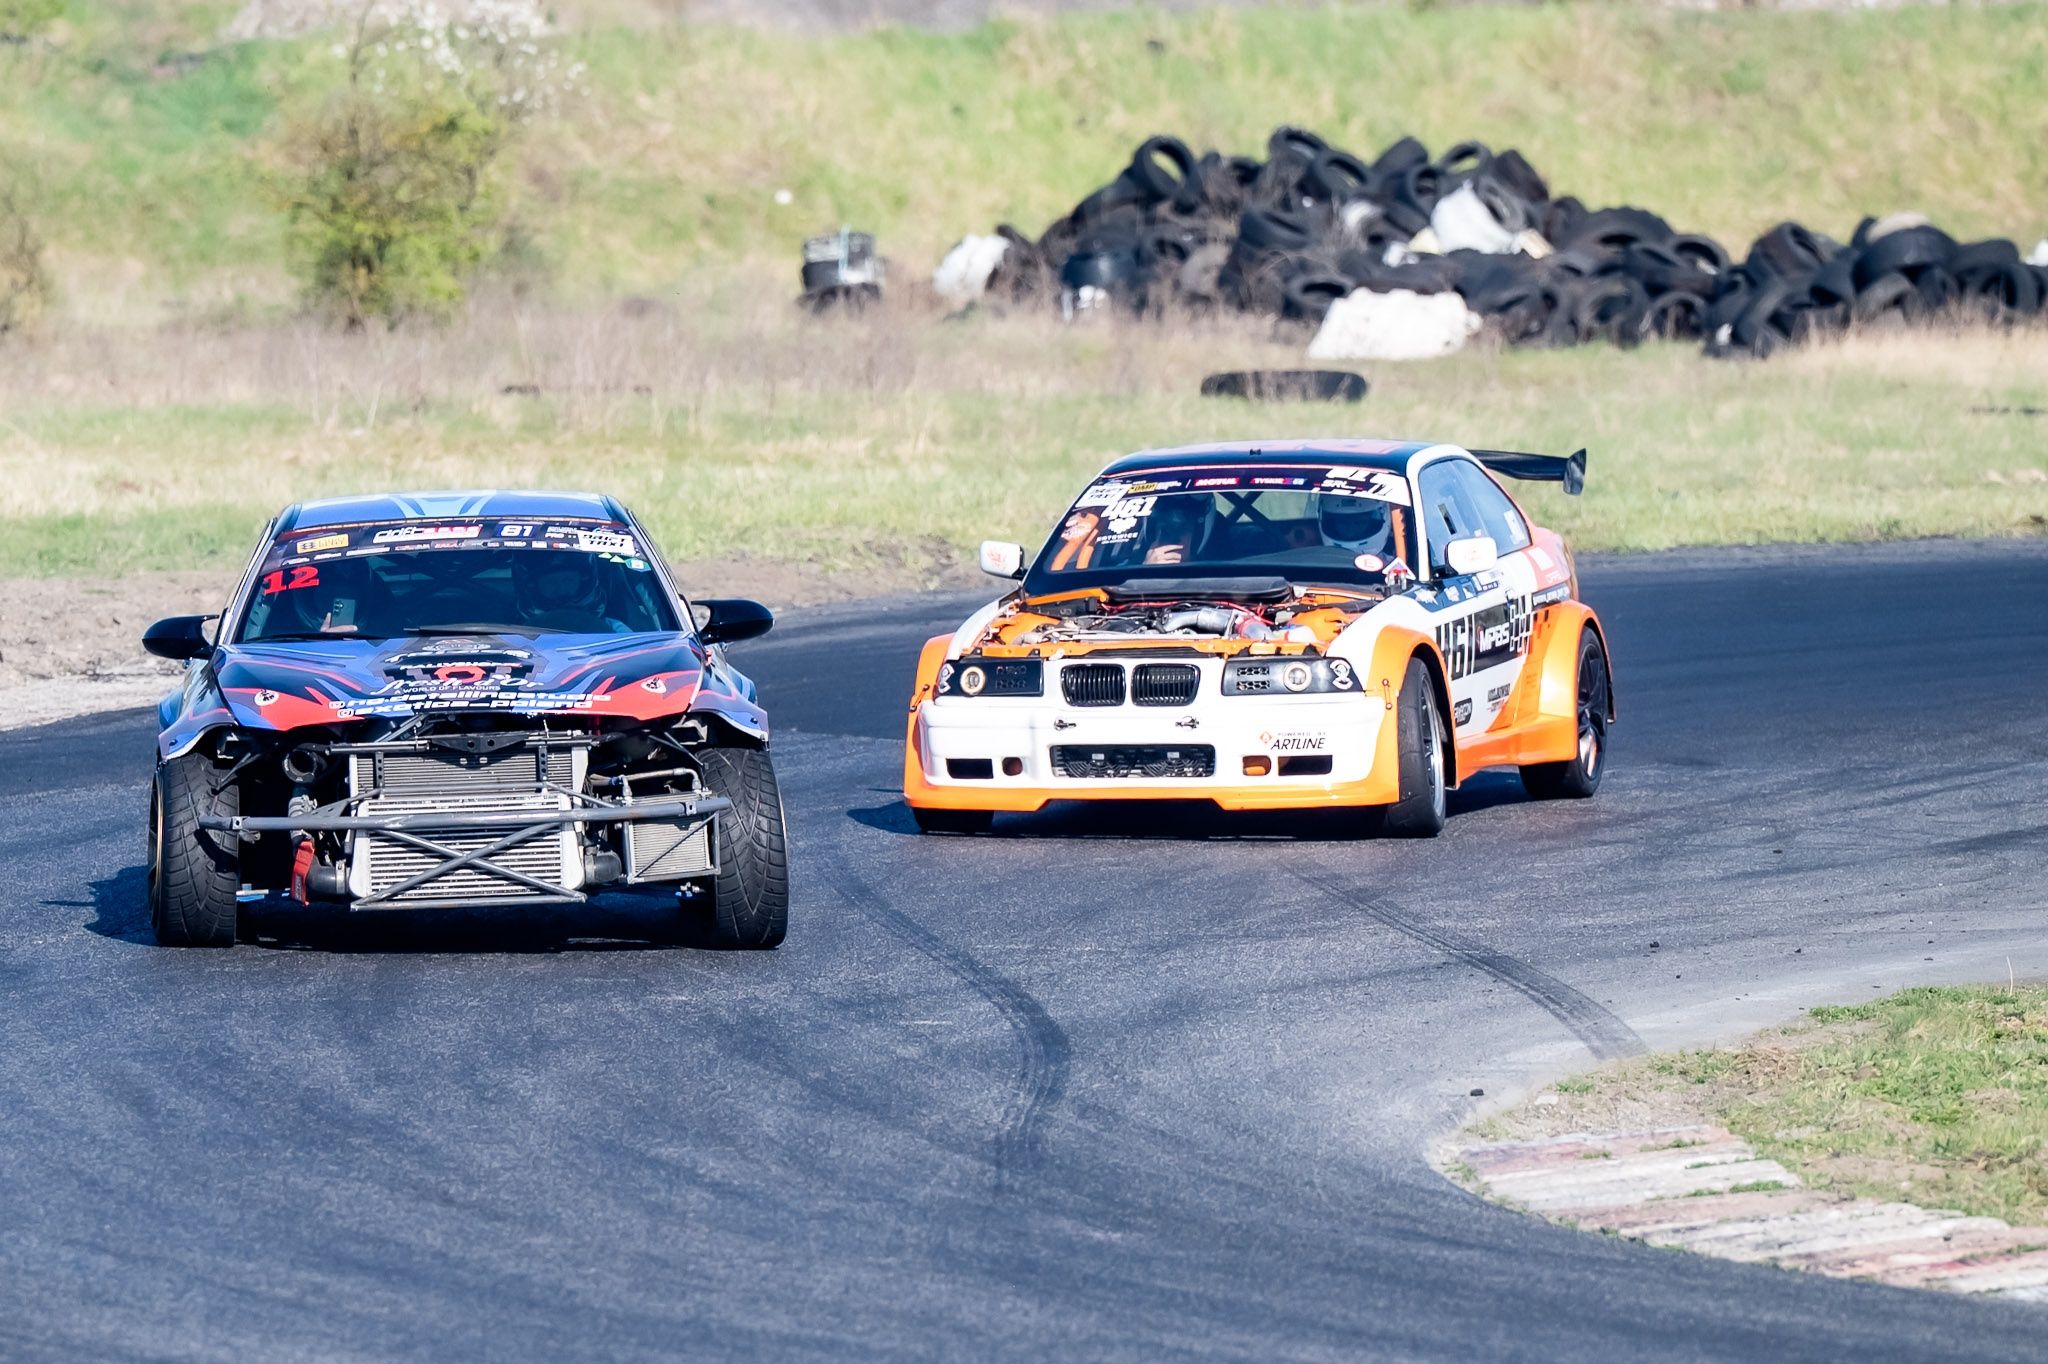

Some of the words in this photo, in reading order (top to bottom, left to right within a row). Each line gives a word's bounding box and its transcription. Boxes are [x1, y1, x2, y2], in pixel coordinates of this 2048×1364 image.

[1195, 477, 1238, 487] MOTUL
[1101, 497, 1158, 520] 461
[500, 525, 533, 537] 81
[589, 539, 625, 548] TAXI
[263, 565, 319, 595] 12
[403, 686, 437, 694] WORLD
[452, 684, 501, 692] FLAVOURS
[1270, 738, 1326, 750] ARTLINE
